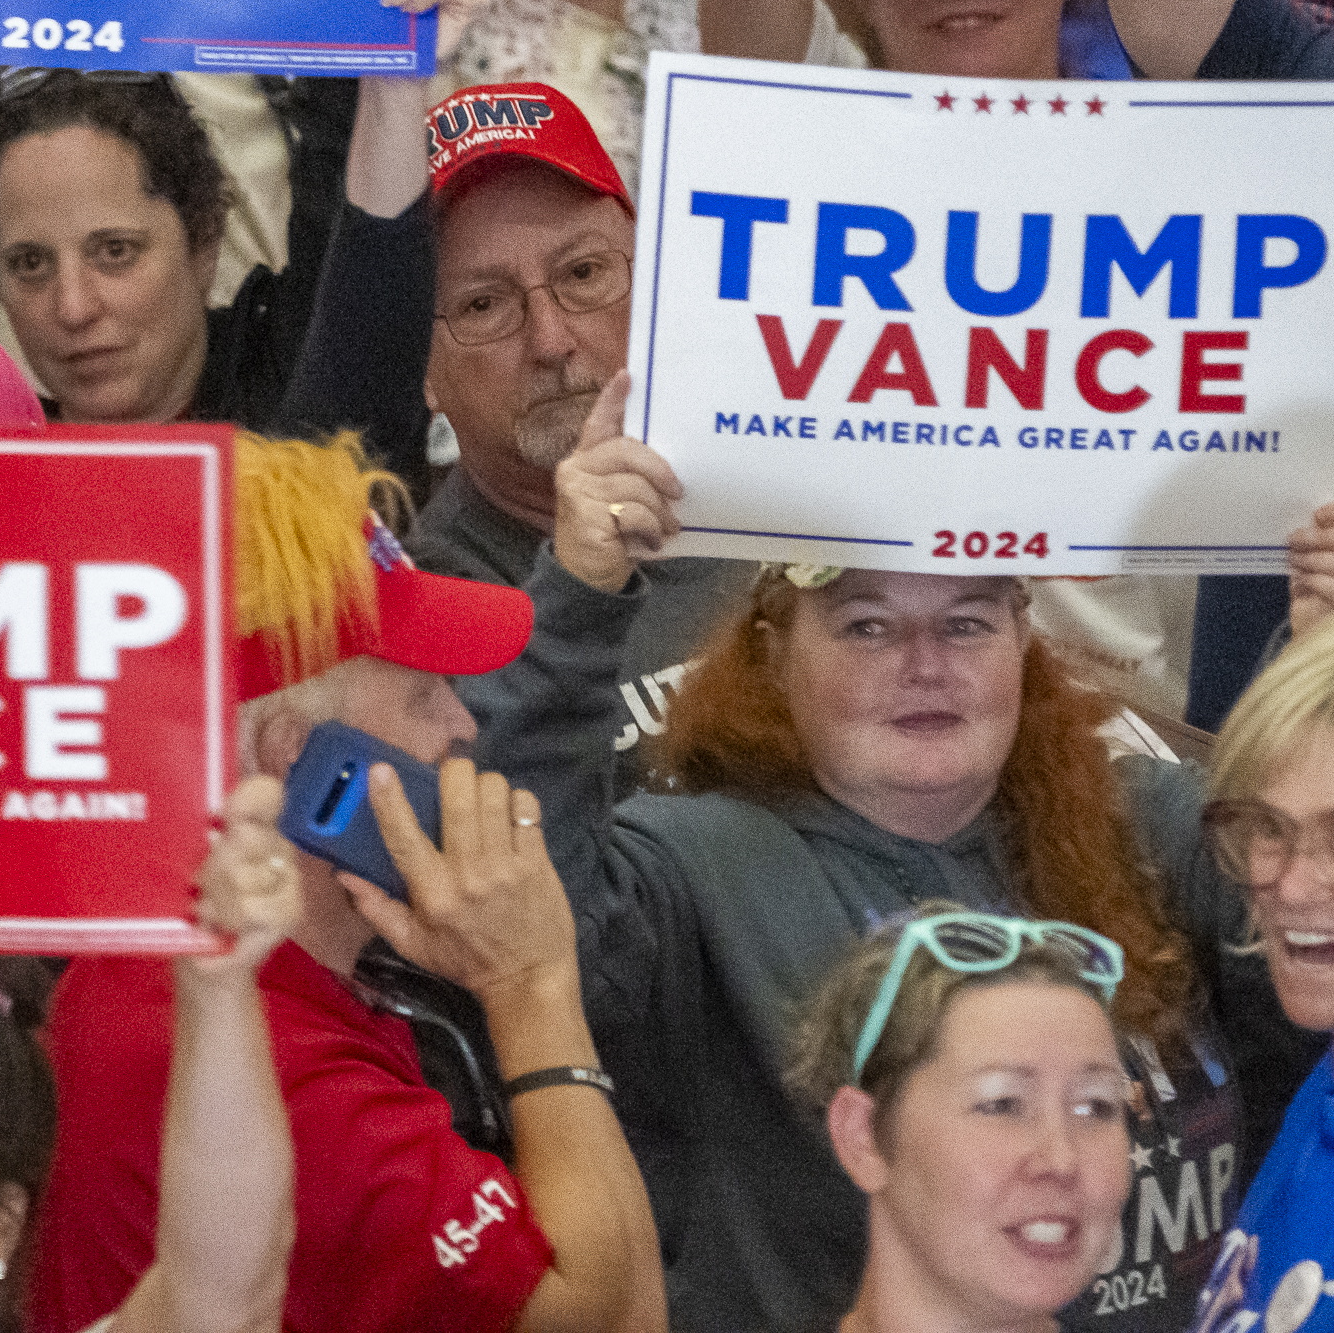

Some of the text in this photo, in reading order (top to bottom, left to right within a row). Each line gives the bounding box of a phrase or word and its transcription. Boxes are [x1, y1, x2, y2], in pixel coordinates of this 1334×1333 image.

[1, 16, 125, 54] 2024
[428, 99, 554, 159] UMP
[456, 129, 536, 155] AMERICA!
[690, 190, 1329, 320] TRUMP
[755, 314, 1251, 415] VANCE
[715, 411, 1282, 454] MAKE AMERICA GREAT AGAIN!
[932, 530, 1051, 560] 2024
[2, 792, 147, 822] AGAIN!
[431, 1179, 516, 1268] 45-47
[1094, 1264, 1167, 1316] 2024
